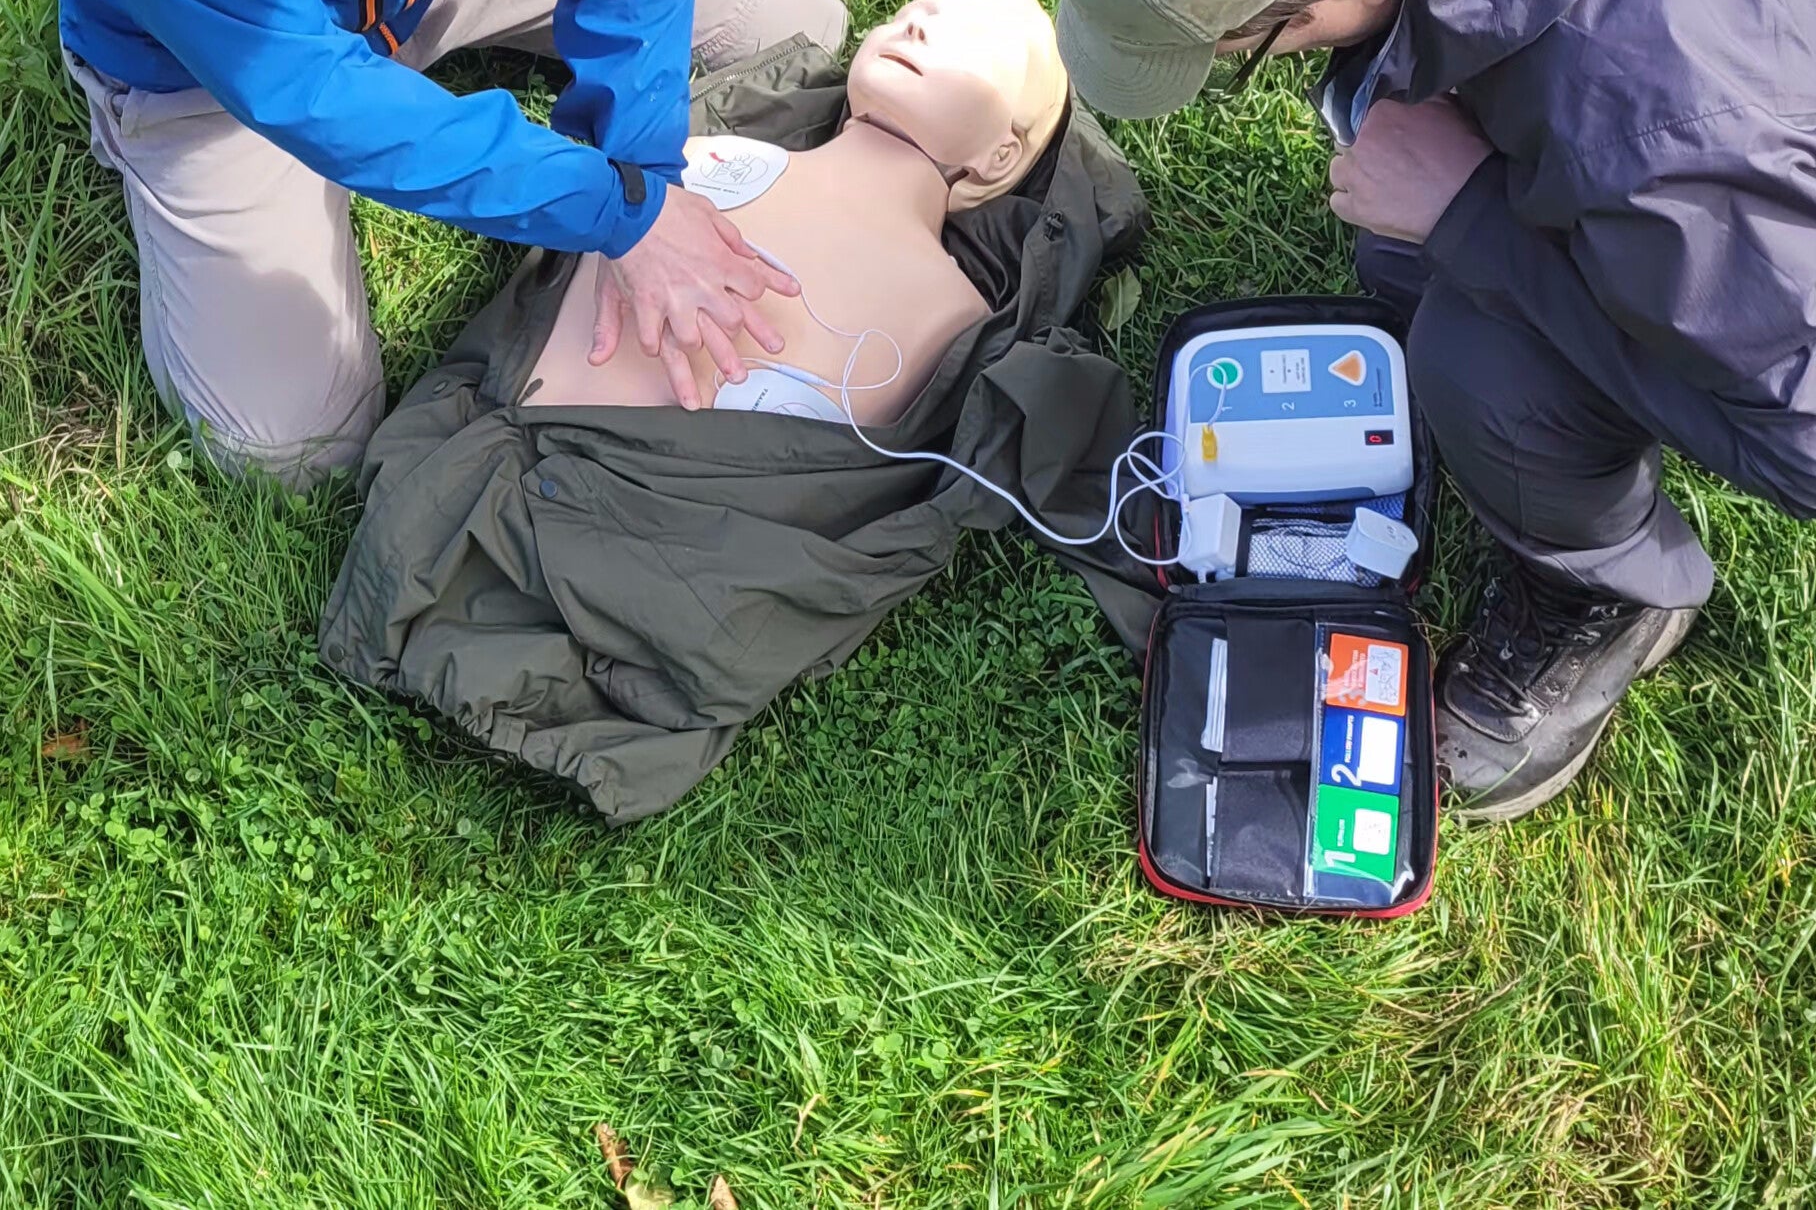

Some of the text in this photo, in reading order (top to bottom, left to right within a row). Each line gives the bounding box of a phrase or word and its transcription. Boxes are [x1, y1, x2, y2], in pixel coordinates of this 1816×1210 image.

[1281, 401, 1295, 411] 2
[1343, 398, 1357, 408] 3
[1331, 763, 1362, 787] 2
[1324, 850, 1356, 868] 1
